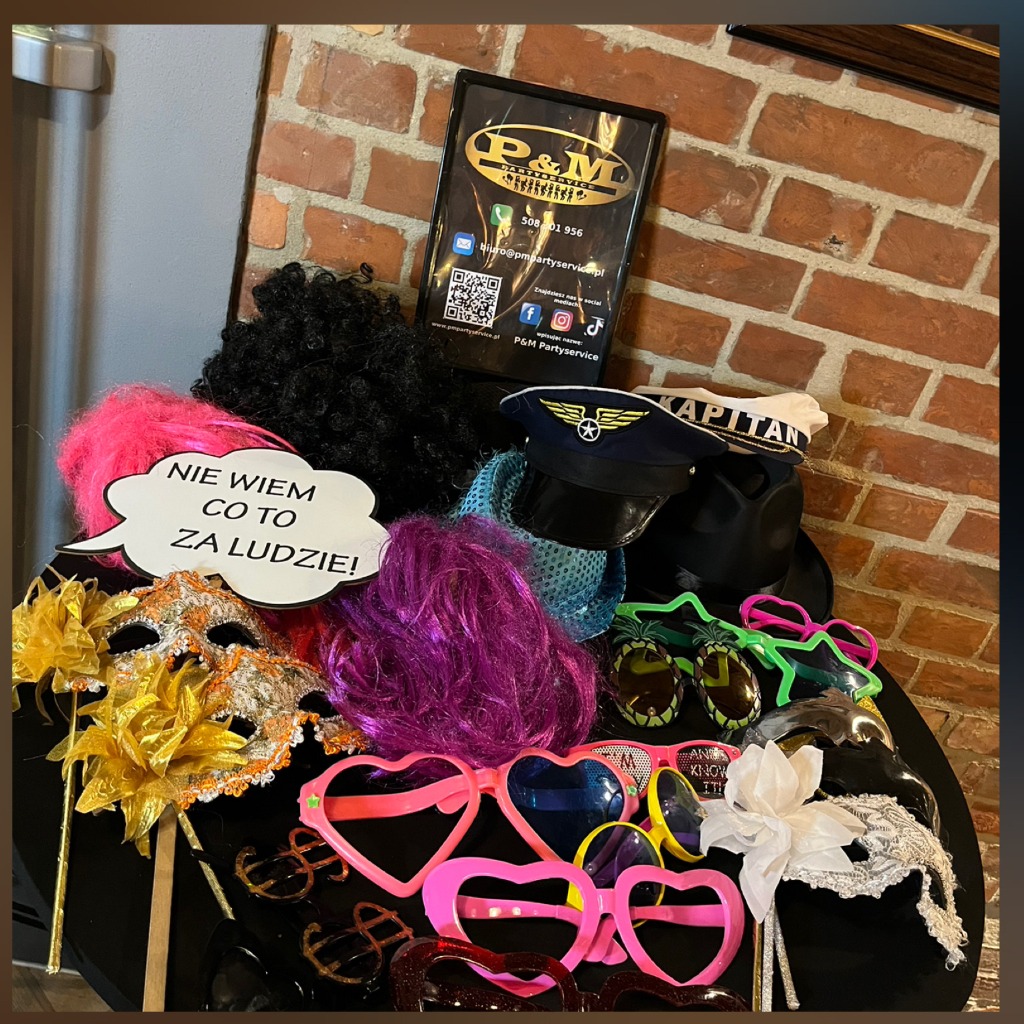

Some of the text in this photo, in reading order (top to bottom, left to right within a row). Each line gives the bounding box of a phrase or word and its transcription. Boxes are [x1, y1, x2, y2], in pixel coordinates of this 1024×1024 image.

[476, 132, 624, 185] P&M
[500, 163, 596, 191] PARTYSERVICE
[521, 216, 584, 237] 508 01 956
[534, 286, 566, 300] Znajdziesz
[584, 298, 602, 306] social
[514, 336, 599, 361] P&M Partyservice
[659, 395, 799, 447] KAPITAN
[167, 462, 316, 502] NIE WIEM
[202, 498, 297, 528] CO TO
[170, 528, 359, 576] ZA LUDZIE!
